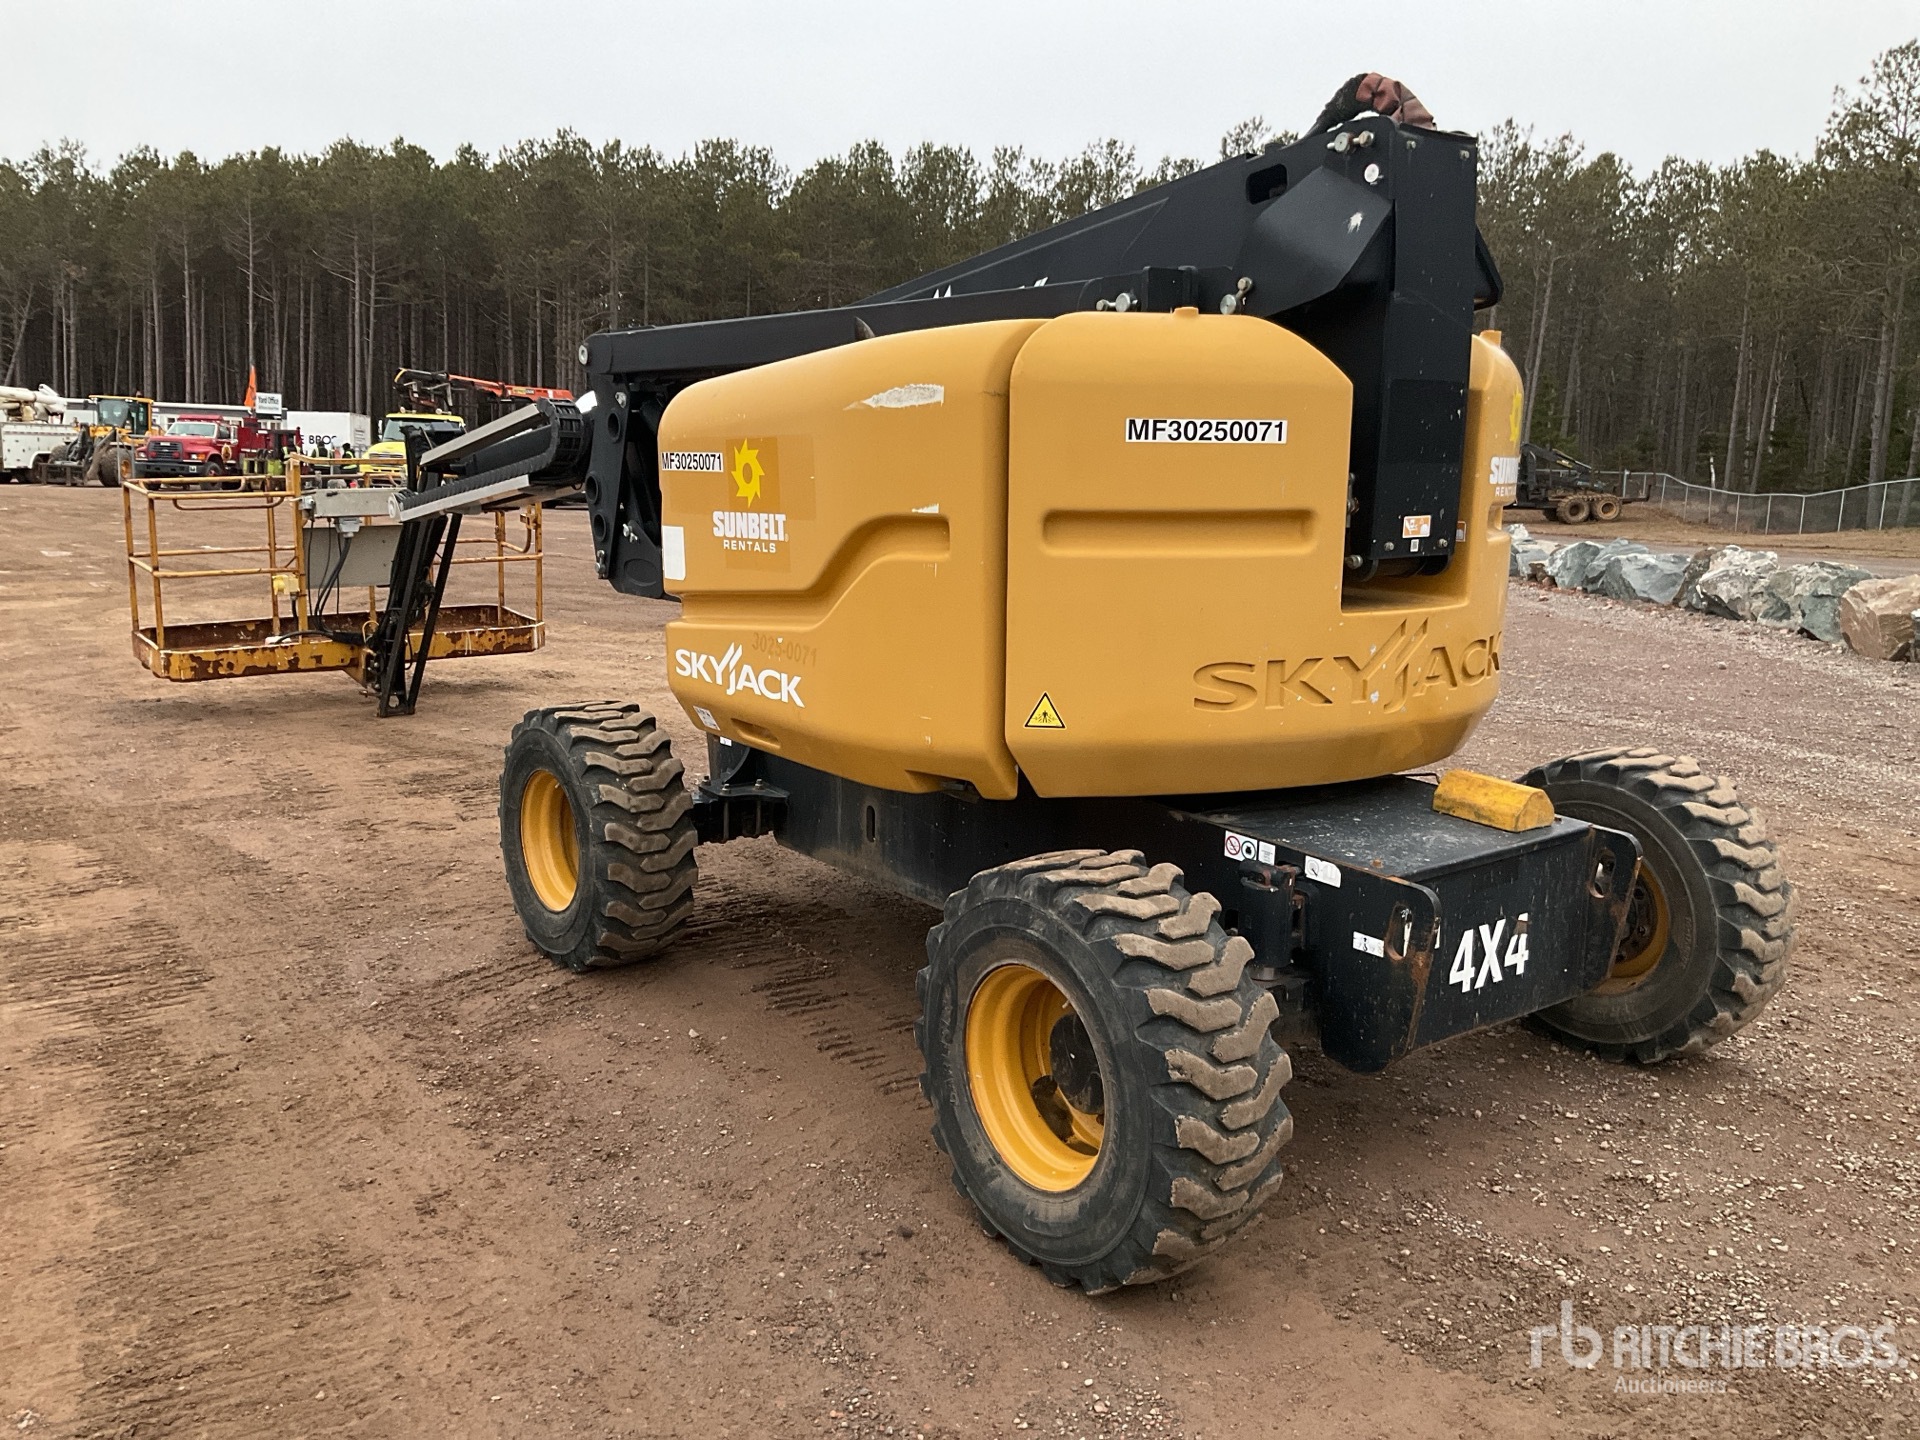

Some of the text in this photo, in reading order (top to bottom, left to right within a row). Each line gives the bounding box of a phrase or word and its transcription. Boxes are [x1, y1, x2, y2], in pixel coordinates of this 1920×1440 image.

[1128, 419, 1283, 442] MF30250071
[662, 452, 722, 471] MF30250071
[712, 510, 787, 542] SUNBELT
[723, 539, 777, 554] RENTALS
[675, 642, 806, 709] SKYJACK
[1193, 617, 1503, 713] SKYJACK
[1448, 912, 1530, 993] 4X4
